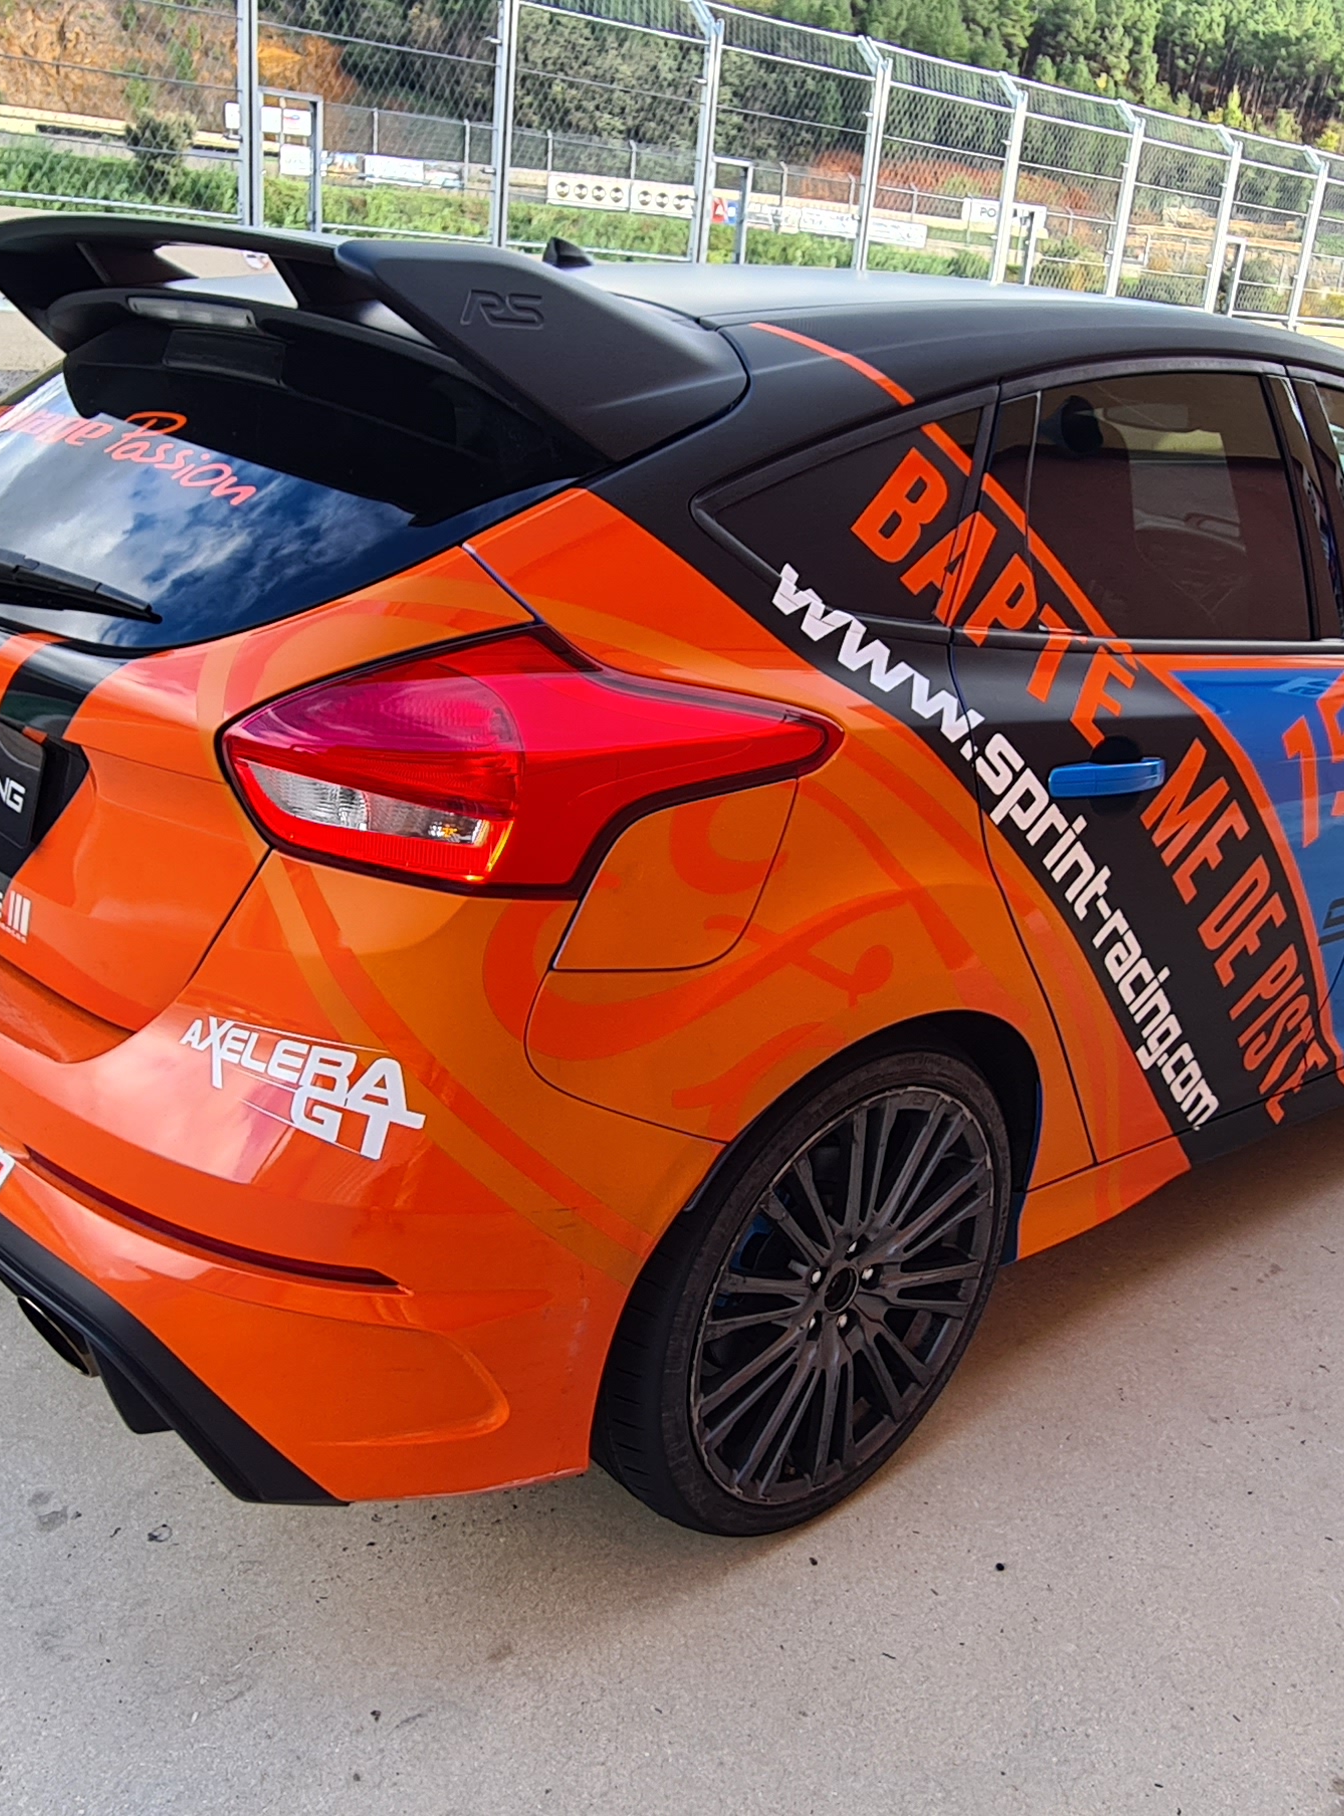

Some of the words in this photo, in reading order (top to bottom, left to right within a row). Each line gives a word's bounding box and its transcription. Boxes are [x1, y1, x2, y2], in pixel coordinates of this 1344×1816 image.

[460, 288, 545, 331] RS
[103, 410, 257, 507] Passion
[770, 562, 1220, 1132] www.sprint-racing.com
